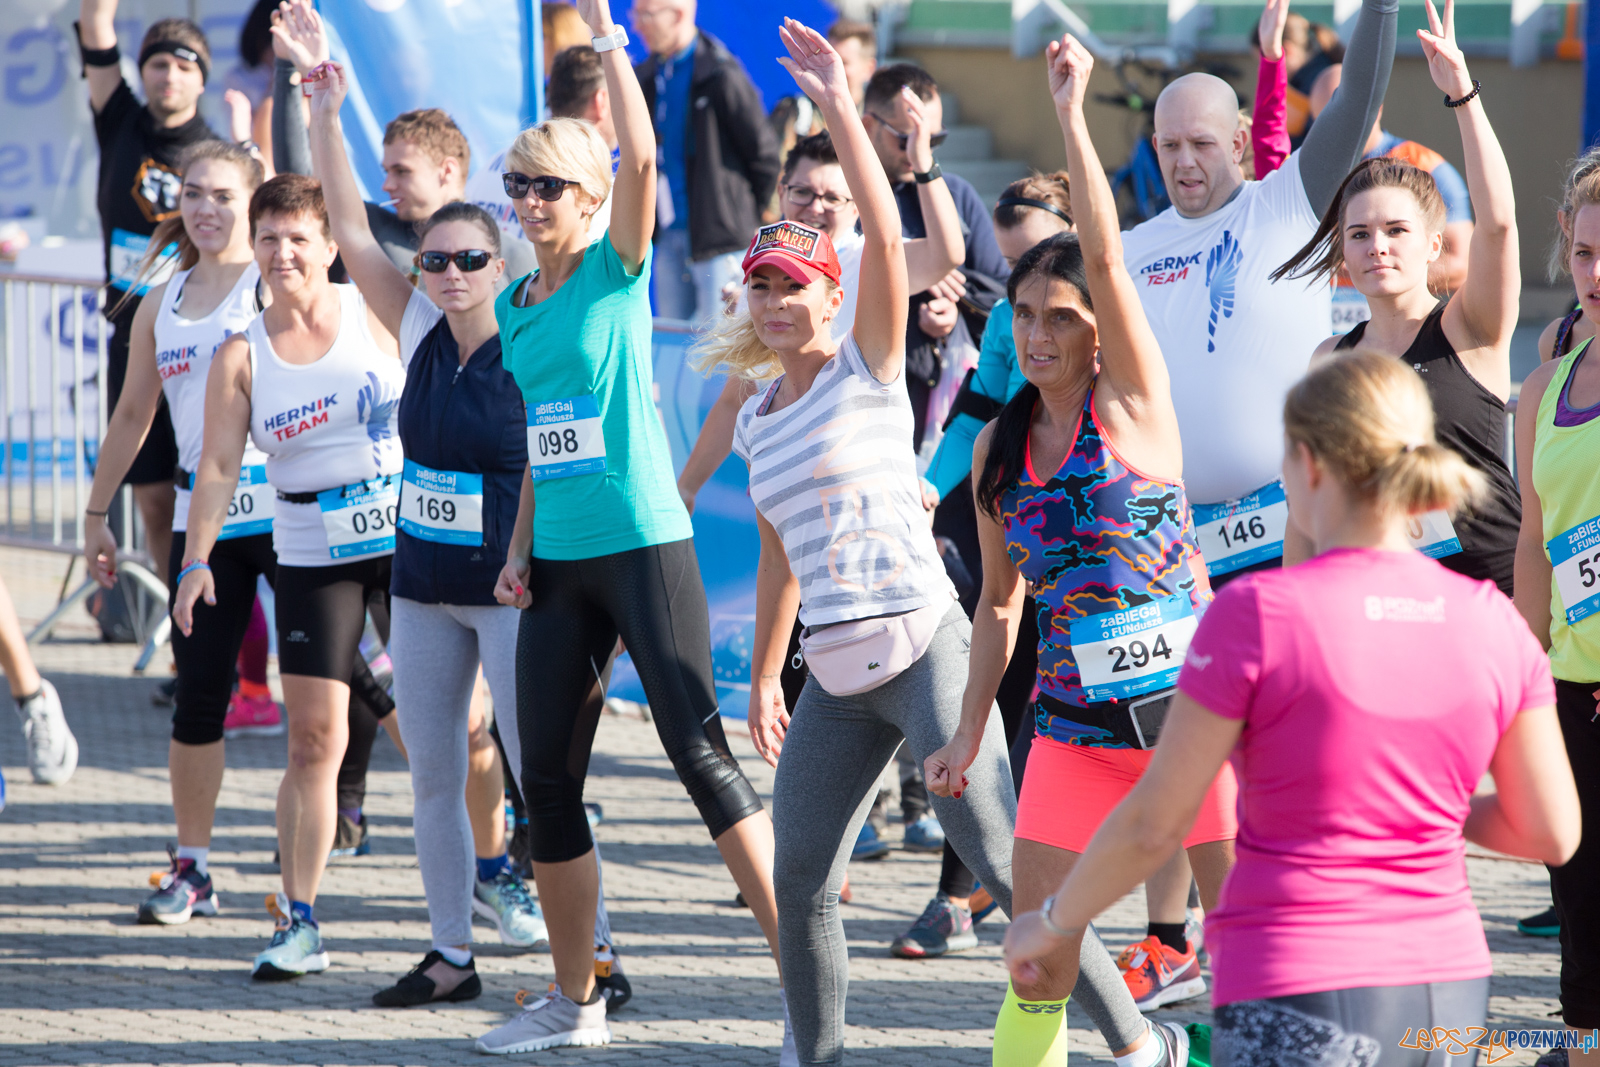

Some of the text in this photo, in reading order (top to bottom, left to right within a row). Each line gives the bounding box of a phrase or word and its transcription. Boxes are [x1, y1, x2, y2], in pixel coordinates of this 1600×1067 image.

[1140, 251, 1202, 274] HERNK
[1147, 267, 1189, 287] TEAM
[156, 344, 198, 366] ERNIK
[264, 393, 338, 432] HERNIK
[273, 412, 329, 442] TEAM
[538, 428, 579, 457] 098
[416, 469, 457, 487] zaBIEGaj
[420, 480, 457, 493] FUNdusze
[352, 505, 396, 534] 030
[416, 494, 456, 522] 169
[1218, 516, 1266, 549] 146
[1571, 546, 1577, 554] o
[1100, 602, 1161, 628] zaBIEGaj
[1111, 617, 1163, 637] FUNdusze
[1108, 633, 1172, 673] 294
